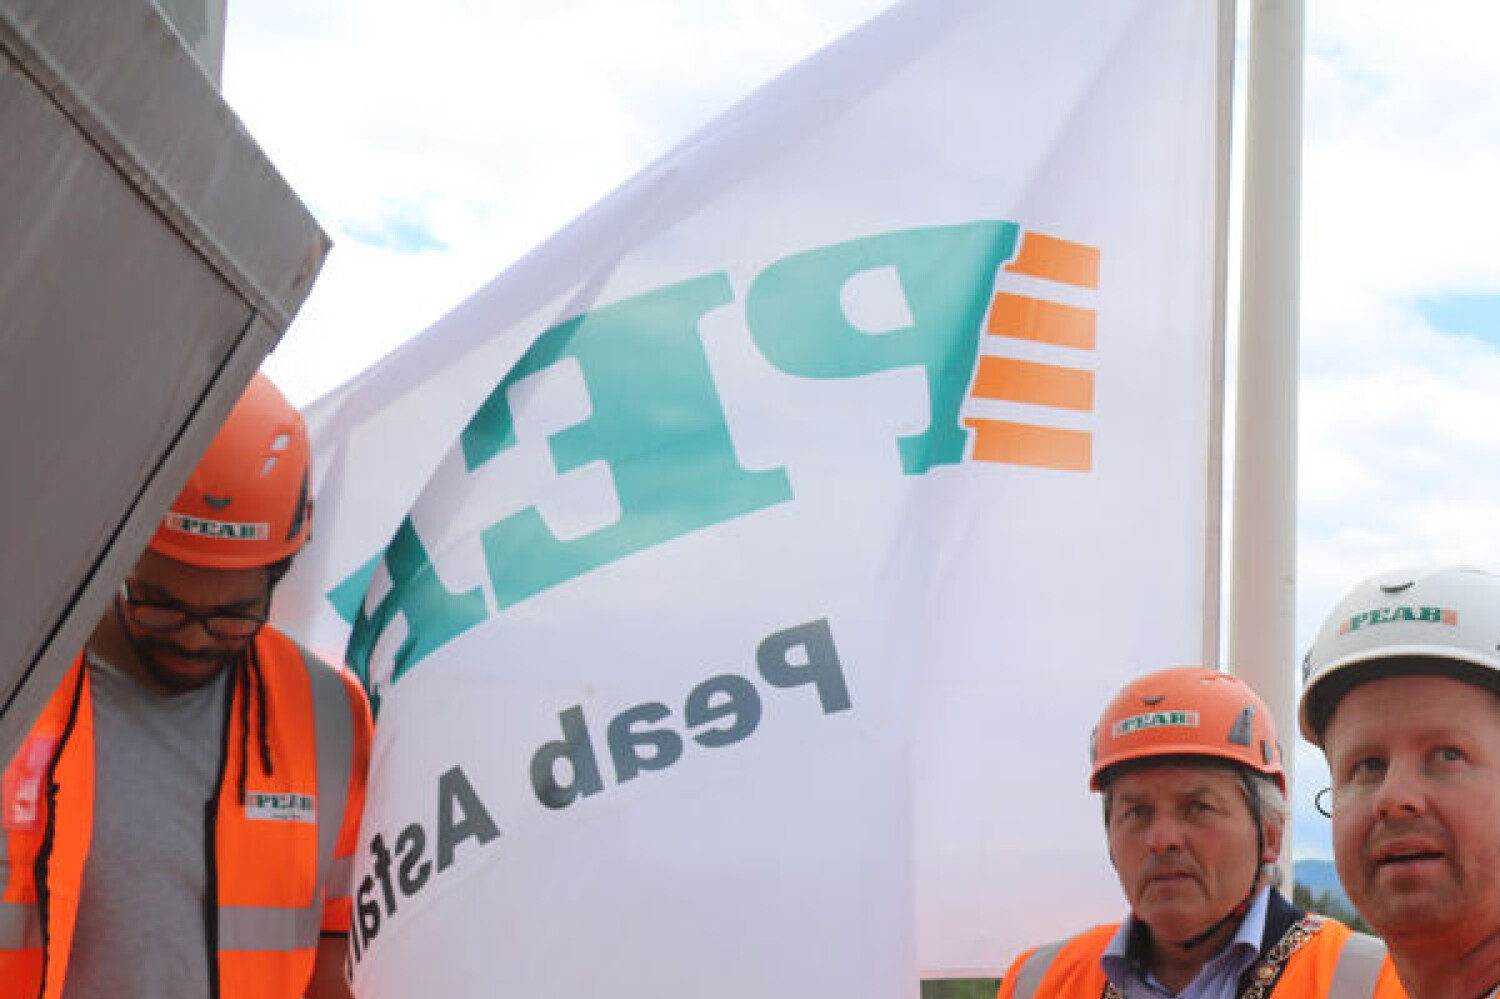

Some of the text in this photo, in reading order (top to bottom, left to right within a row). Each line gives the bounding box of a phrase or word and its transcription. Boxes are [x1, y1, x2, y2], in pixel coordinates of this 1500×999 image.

[181, 517, 256, 537] PEAB
[1350, 607, 1441, 630] PEAB
[1122, 714, 1186, 734] PEAB
[256, 793, 311, 811] PEAB
